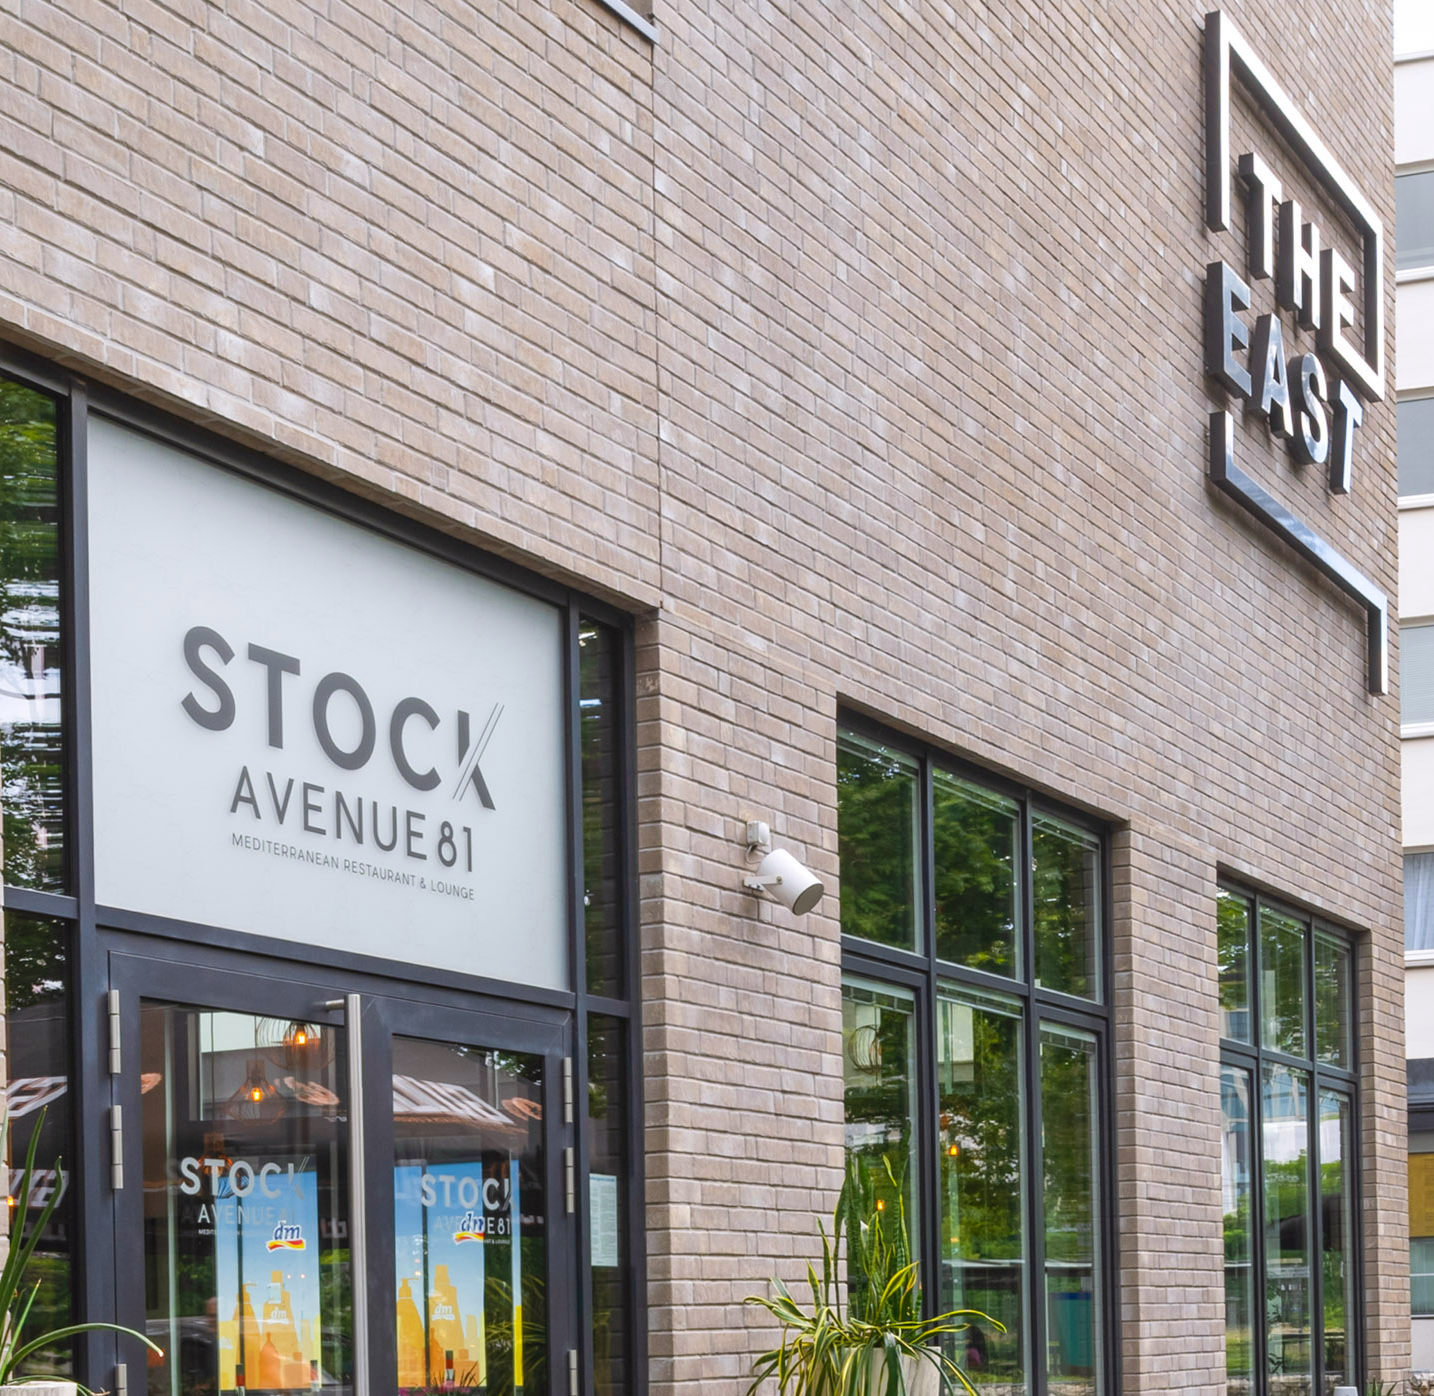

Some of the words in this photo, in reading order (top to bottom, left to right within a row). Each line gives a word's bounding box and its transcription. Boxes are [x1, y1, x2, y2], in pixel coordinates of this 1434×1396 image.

[1239, 152, 1357, 350] THE
[1207, 260, 1363, 494] EAST
[180, 625, 505, 811] STOCK
[232, 832, 339, 869] MEDITERRANEAN
[343, 859, 415, 886] RESTAURANT
[419, 876, 427, 889] &
[431, 879, 475, 900] LOUNGE
[180, 1156, 310, 1200] STOCK
[273, 1222, 302, 1241] dm
